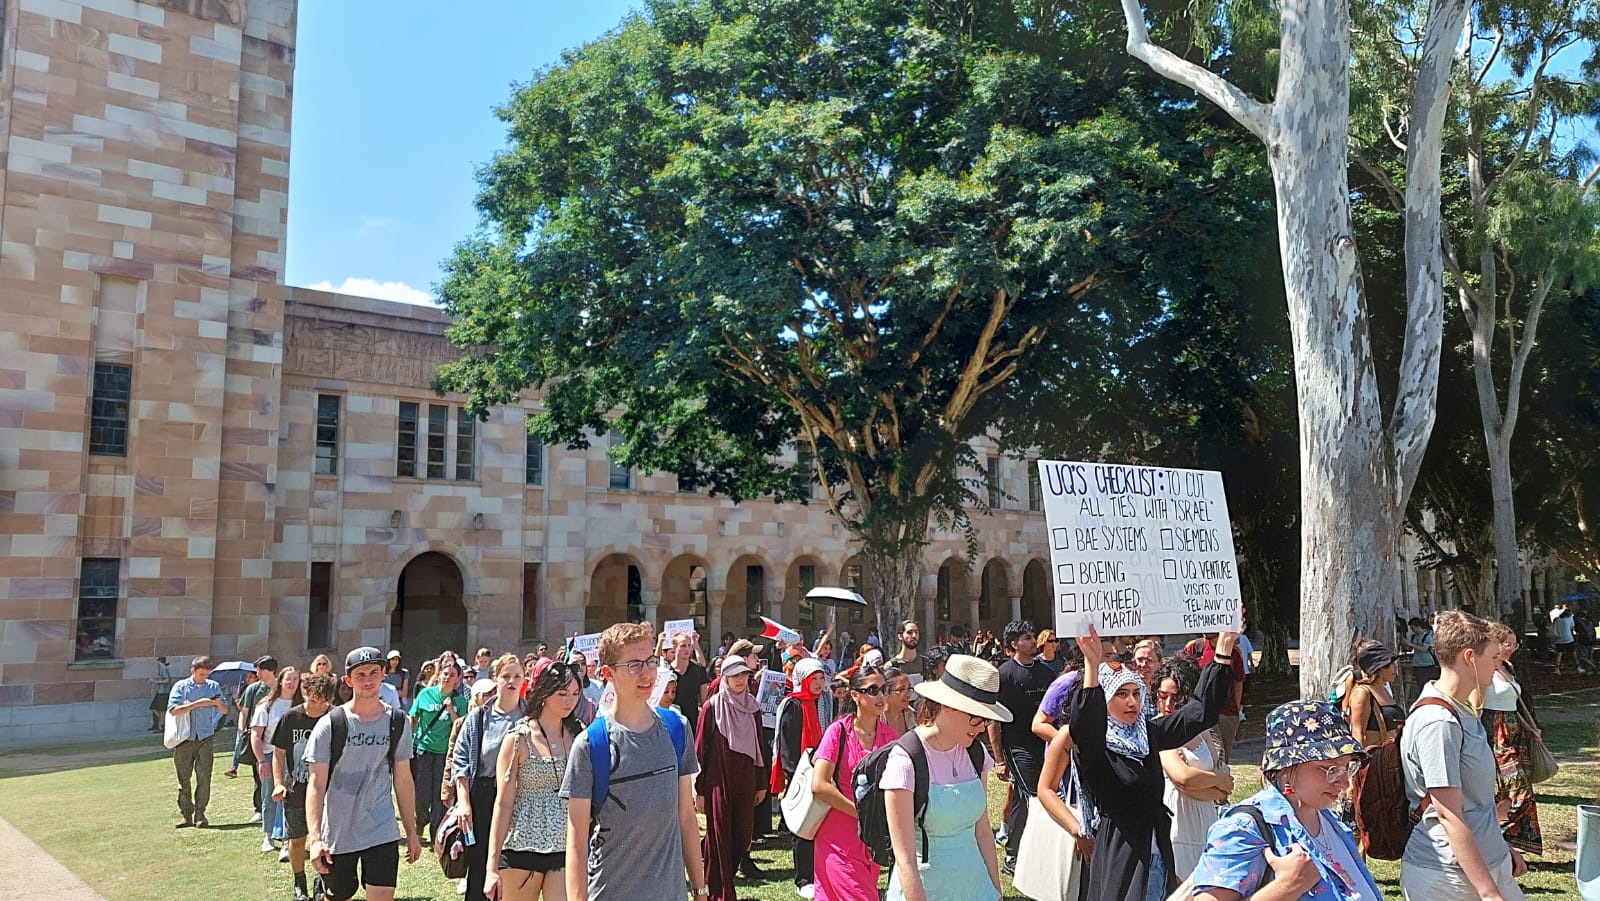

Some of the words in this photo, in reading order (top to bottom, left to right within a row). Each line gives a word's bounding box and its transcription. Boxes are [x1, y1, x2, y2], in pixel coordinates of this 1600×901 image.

[1046, 463, 1087, 496] UQ'S
[1094, 465, 1163, 497] CHECKLIST:
[1165, 470, 1180, 496] TO
[1185, 471, 1204, 498] CUT
[1079, 497, 1104, 517] ALL
[1109, 495, 1136, 518] TIES
[1144, 498, 1168, 520] WITH
[1075, 527, 1098, 551] BAE
[1101, 525, 1147, 552] SYSTEMS
[1174, 526, 1220, 552] SIEMENS
[1079, 560, 1126, 585] BOEING
[1179, 559, 1197, 580] UQ
[1198, 560, 1233, 580] VENTURE
[1082, 588, 1140, 612] LOCKHEED
[1183, 583, 1210, 595] VISITS
[1213, 583, 1225, 596] TO
[1225, 598, 1239, 612] CUT
[1102, 609, 1142, 629] MARTIN
[1183, 614, 1234, 629] PERMANENTLY
